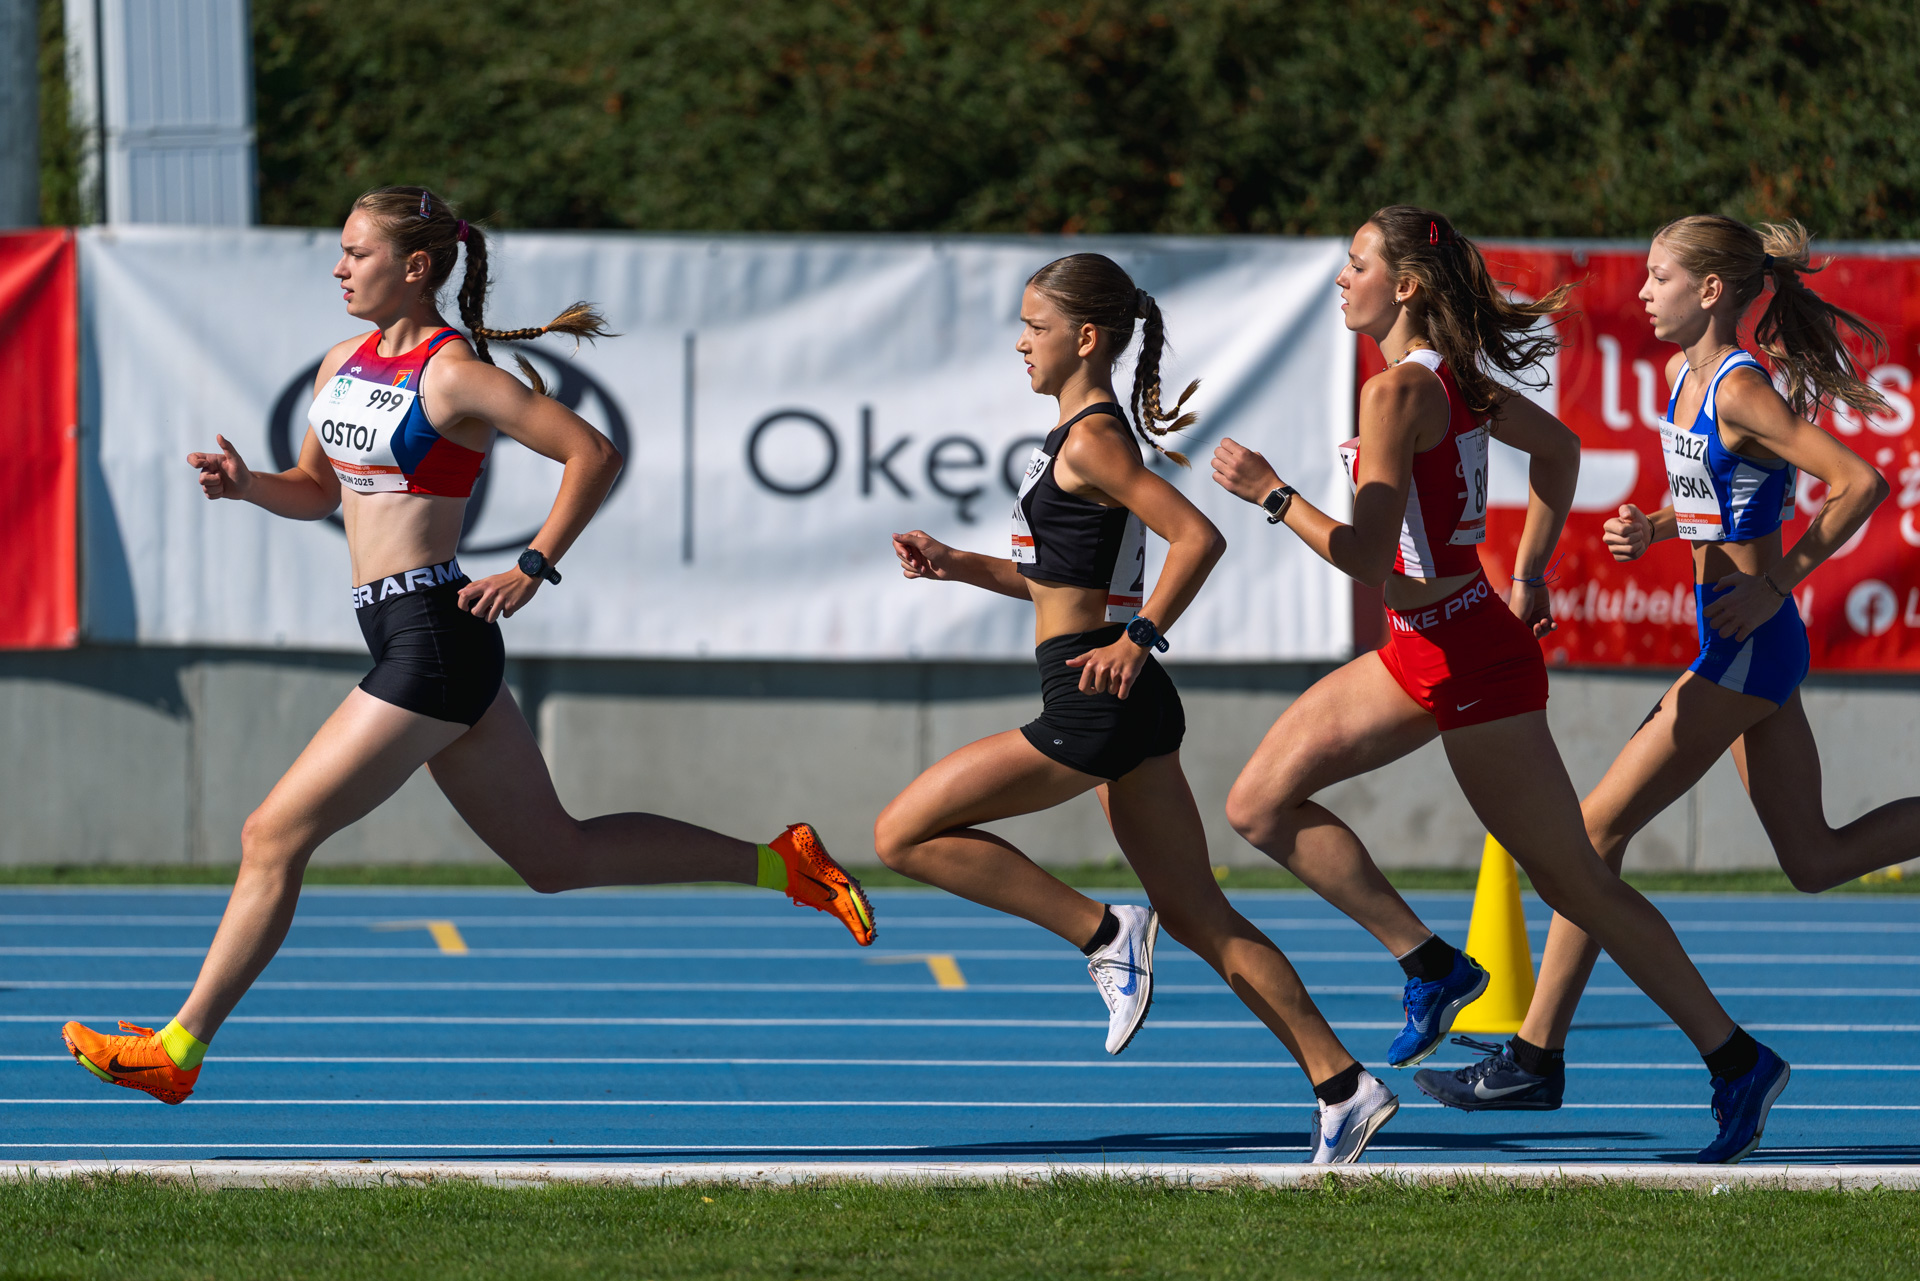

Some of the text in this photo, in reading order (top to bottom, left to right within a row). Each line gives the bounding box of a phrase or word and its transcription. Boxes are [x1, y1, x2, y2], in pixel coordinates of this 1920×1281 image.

[366, 389, 404, 412] 999
[321, 419, 377, 453] OSTOJ
[1675, 432, 1705, 461] 1212
[354, 477, 375, 487] 2025
[1667, 470, 1714, 501] WSKA
[1679, 526, 1698, 535] 2025
[1392, 580, 1488, 632] NIKE PRO
